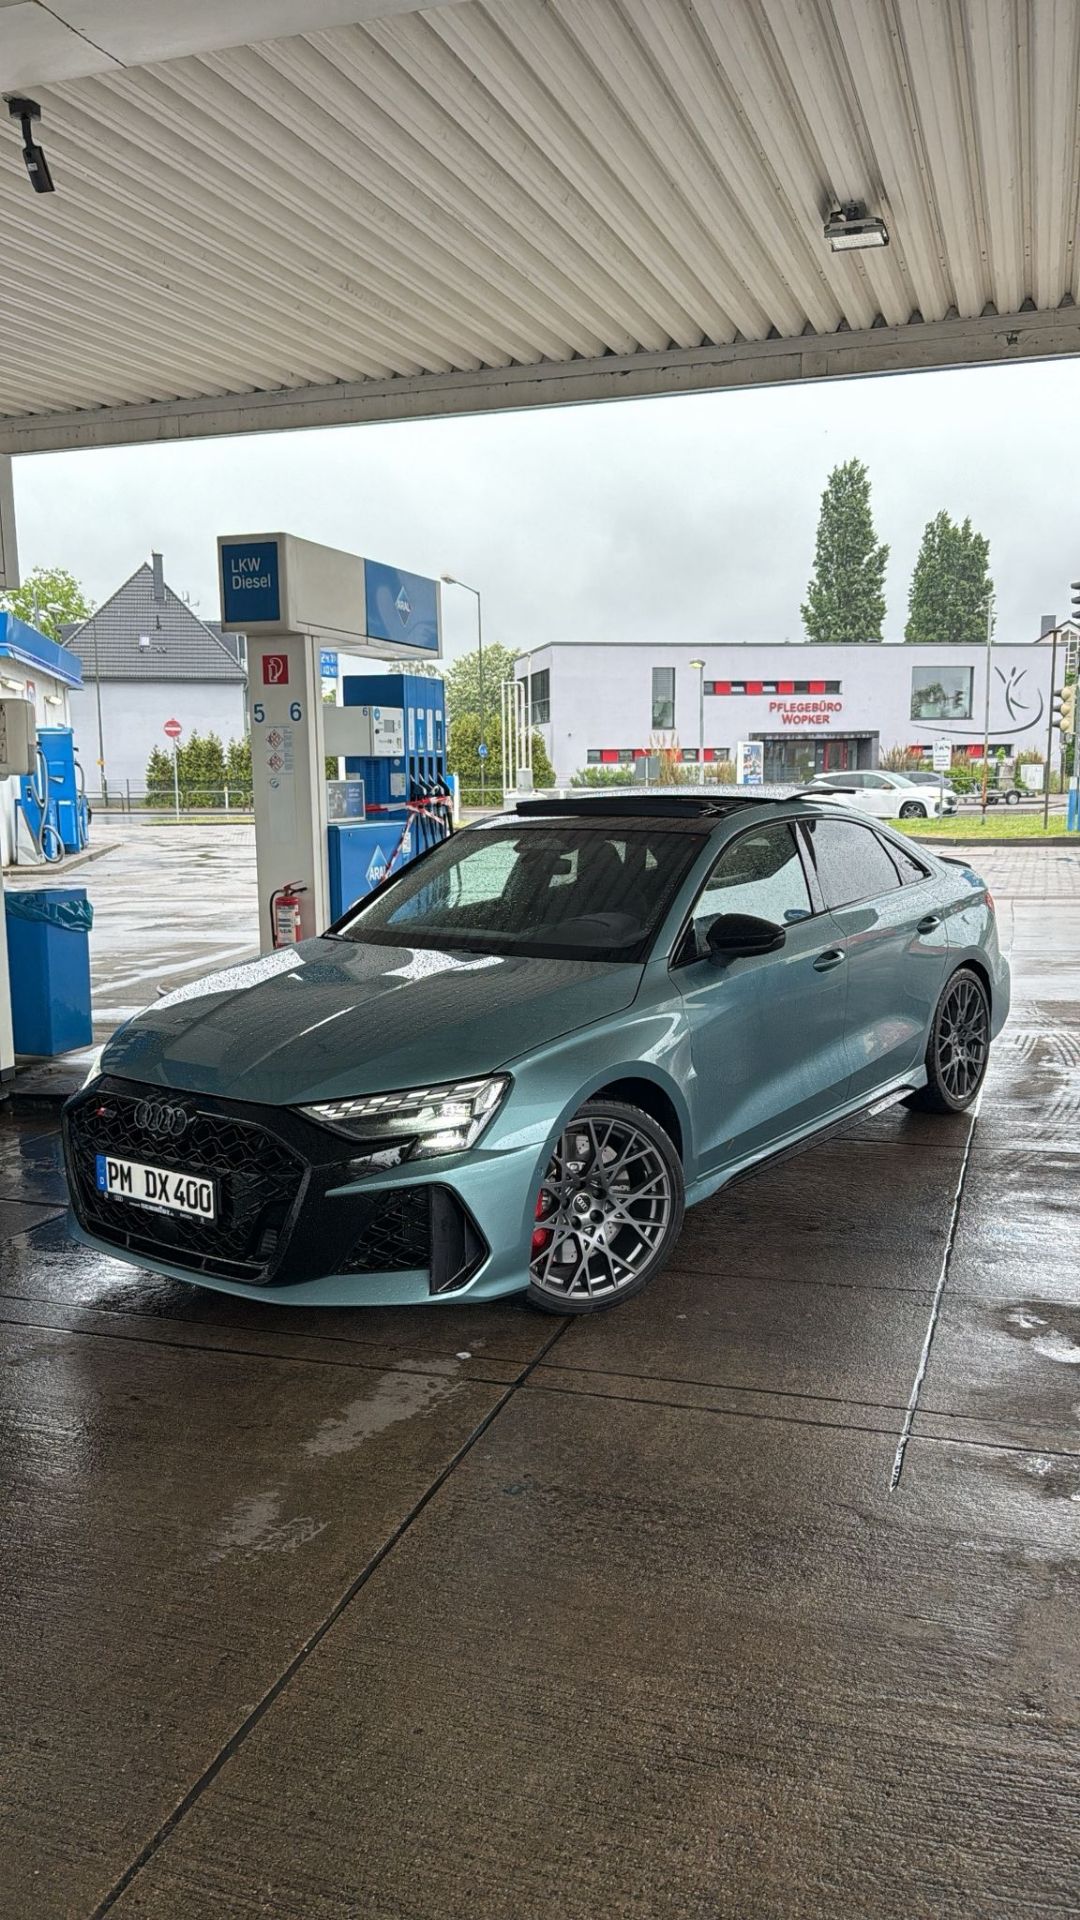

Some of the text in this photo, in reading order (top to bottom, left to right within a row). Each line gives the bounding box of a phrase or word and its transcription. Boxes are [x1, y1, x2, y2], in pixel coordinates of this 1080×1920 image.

[231, 557, 261, 573] LKW
[232, 573, 271, 590] Diesel
[253, 703, 265, 723] 5
[290, 702, 302, 722] 6
[362, 707, 368, 717] 6
[769, 700, 842, 713] PFLEGEBÜRO
[781, 714, 830, 725] WOPKER
[107, 1161, 133, 1193] PM
[144, 1170, 170, 1203] DX
[174, 1178, 211, 1212] 400
